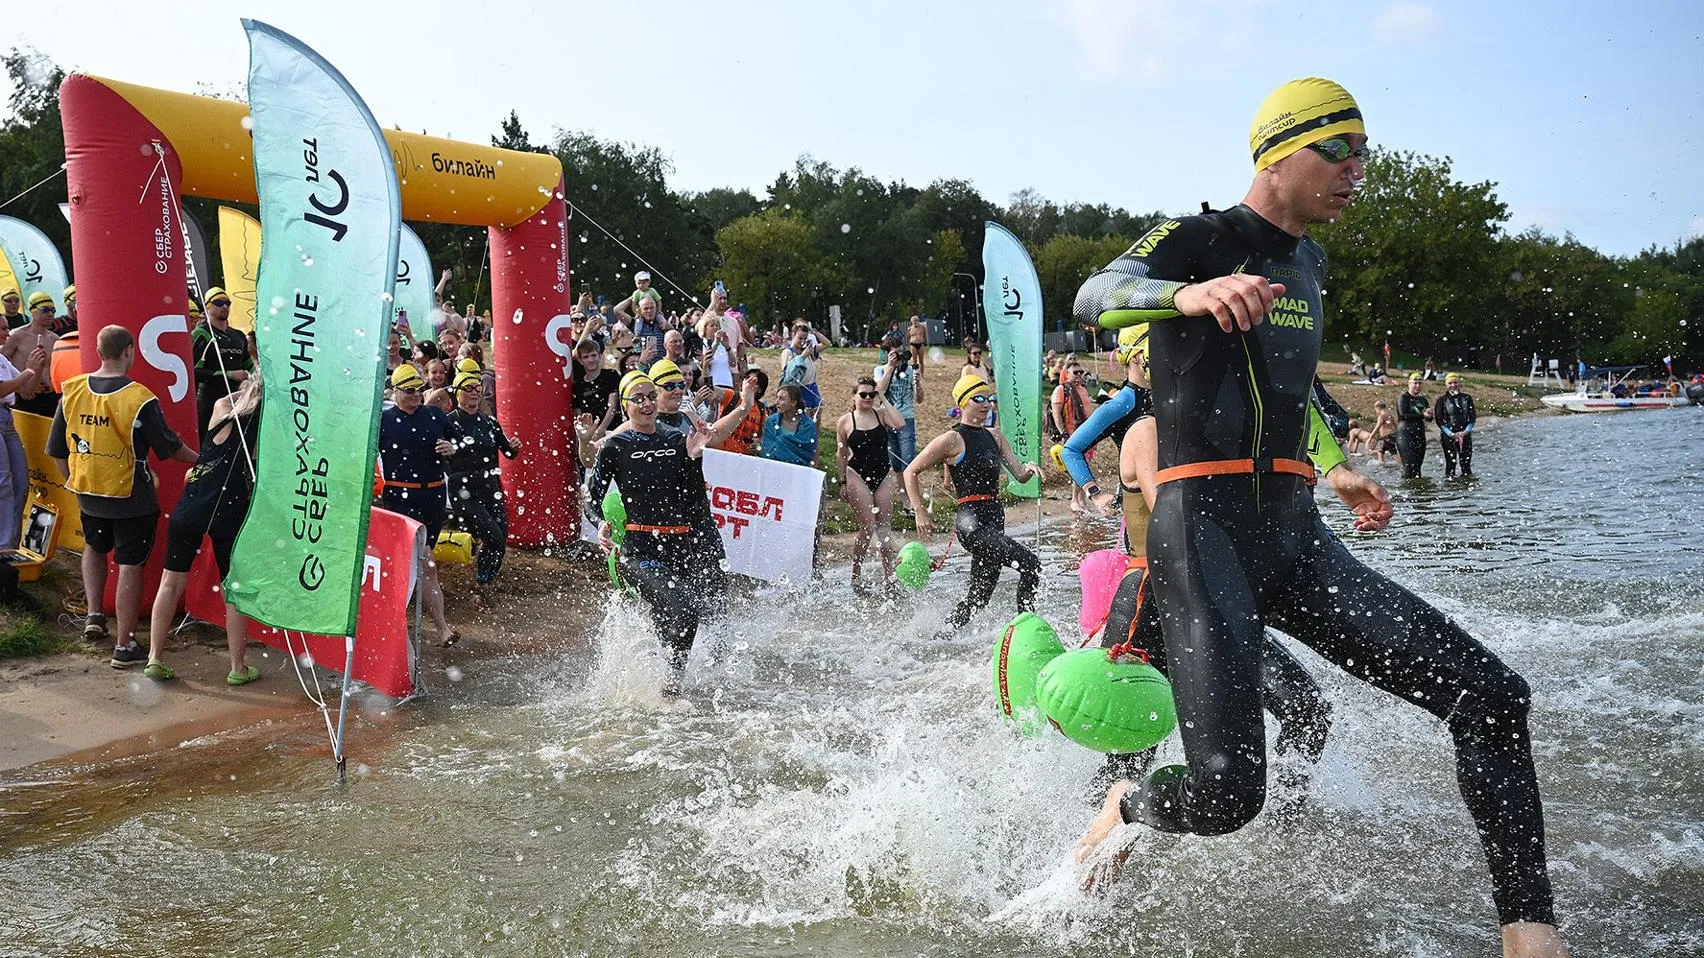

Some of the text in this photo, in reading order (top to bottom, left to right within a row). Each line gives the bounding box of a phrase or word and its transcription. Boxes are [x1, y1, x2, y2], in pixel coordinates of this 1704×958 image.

[431, 152, 496, 180] билайн
[160, 176, 173, 259] СТРАХОВАНИЕ
[155, 228, 165, 259] СБЕР
[1130, 219, 1182, 257] WAVE
[1271, 266, 1303, 280] RAPID
[1273, 297, 1309, 314] MAD
[1267, 311, 1314, 331] WAVE
[80, 414, 110, 427] TEAM
[631, 448, 677, 459] orca
[704, 481, 785, 522] ОБЛ
